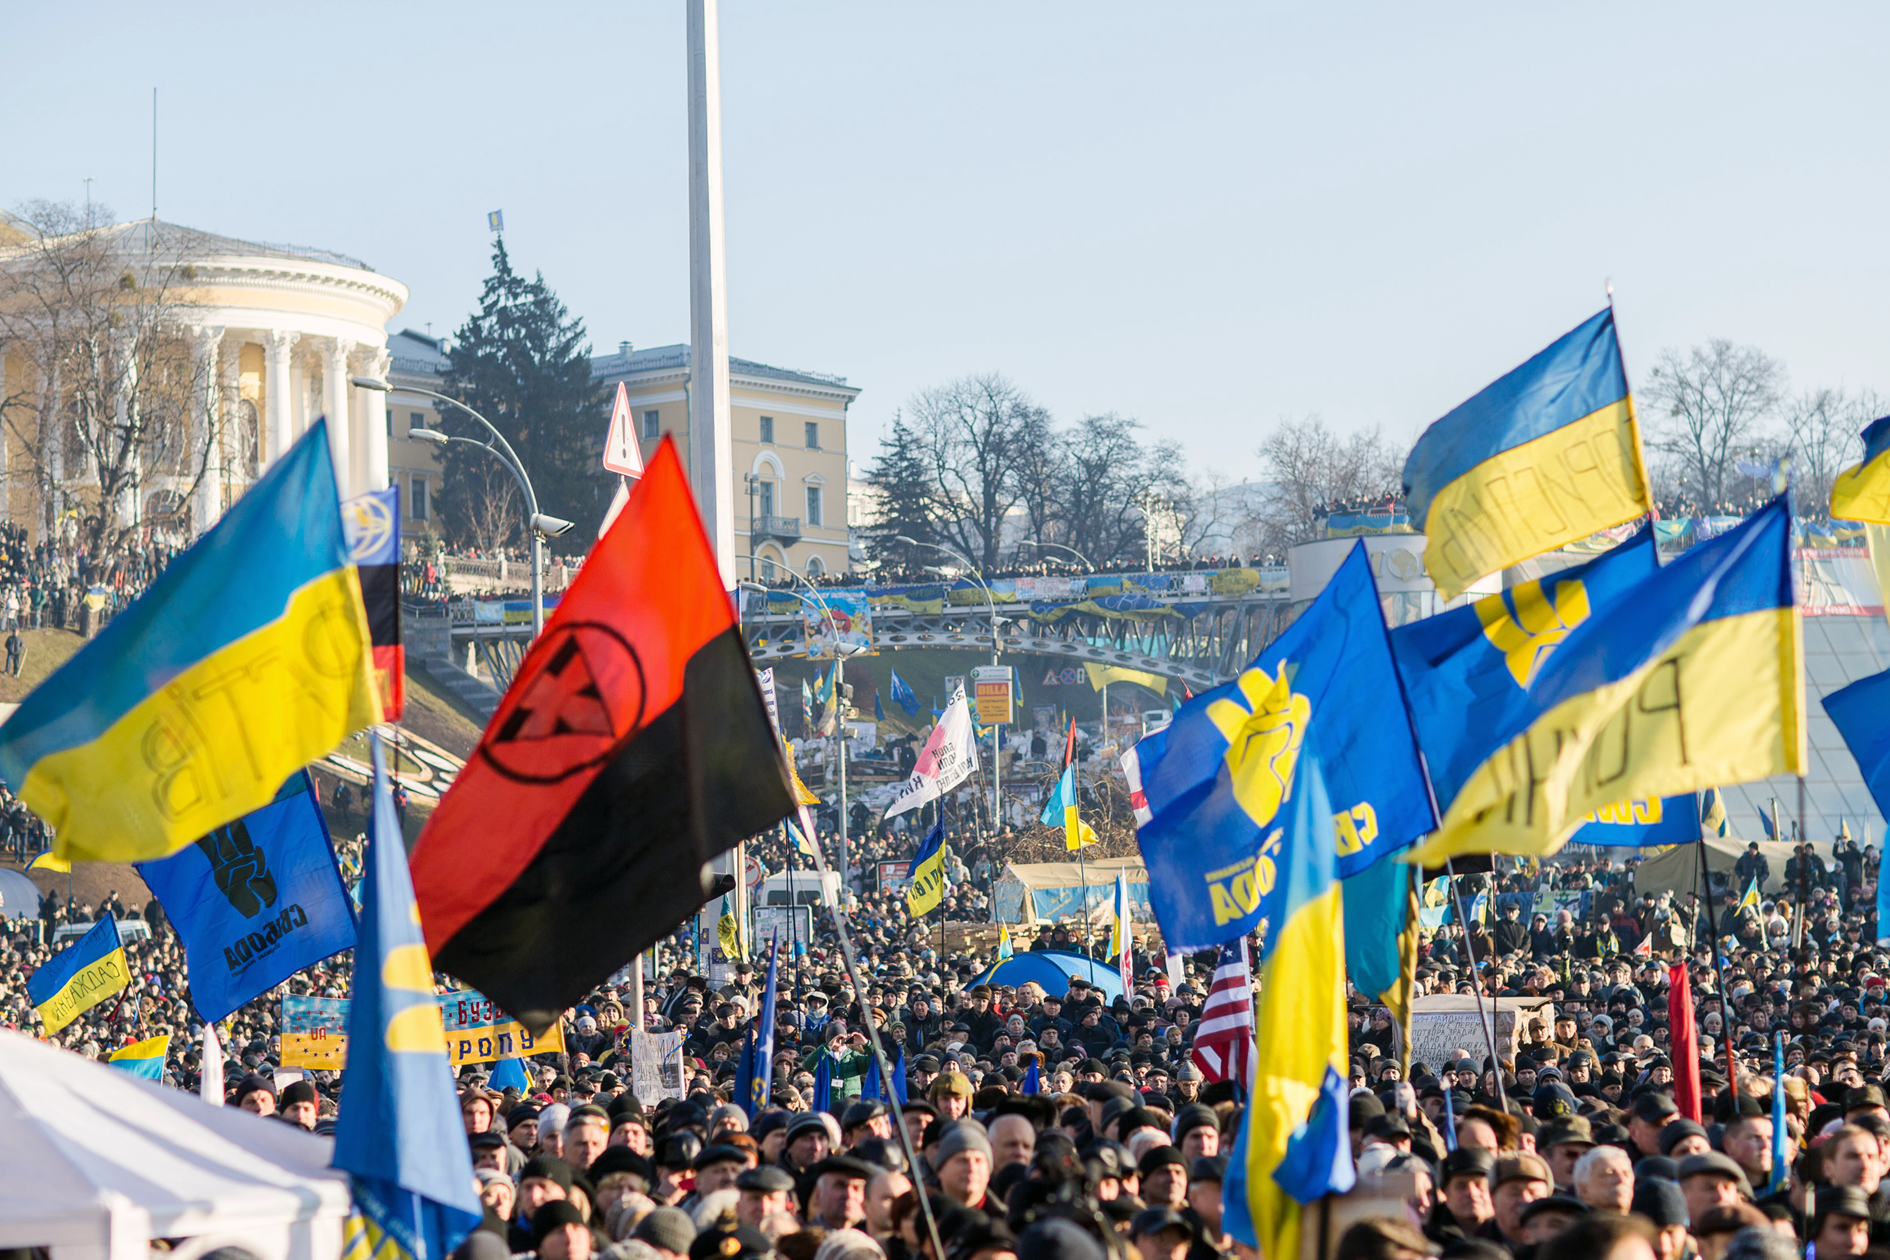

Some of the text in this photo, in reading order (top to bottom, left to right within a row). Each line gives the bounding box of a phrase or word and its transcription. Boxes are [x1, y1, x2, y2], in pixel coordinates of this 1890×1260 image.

[977, 684, 1008, 695] BILLA
[1411, 1013, 1483, 1023] ДИН МАЙДАН НАРО
[310, 1028, 327, 1041] UA
[447, 1029, 535, 1060] РОПУ
